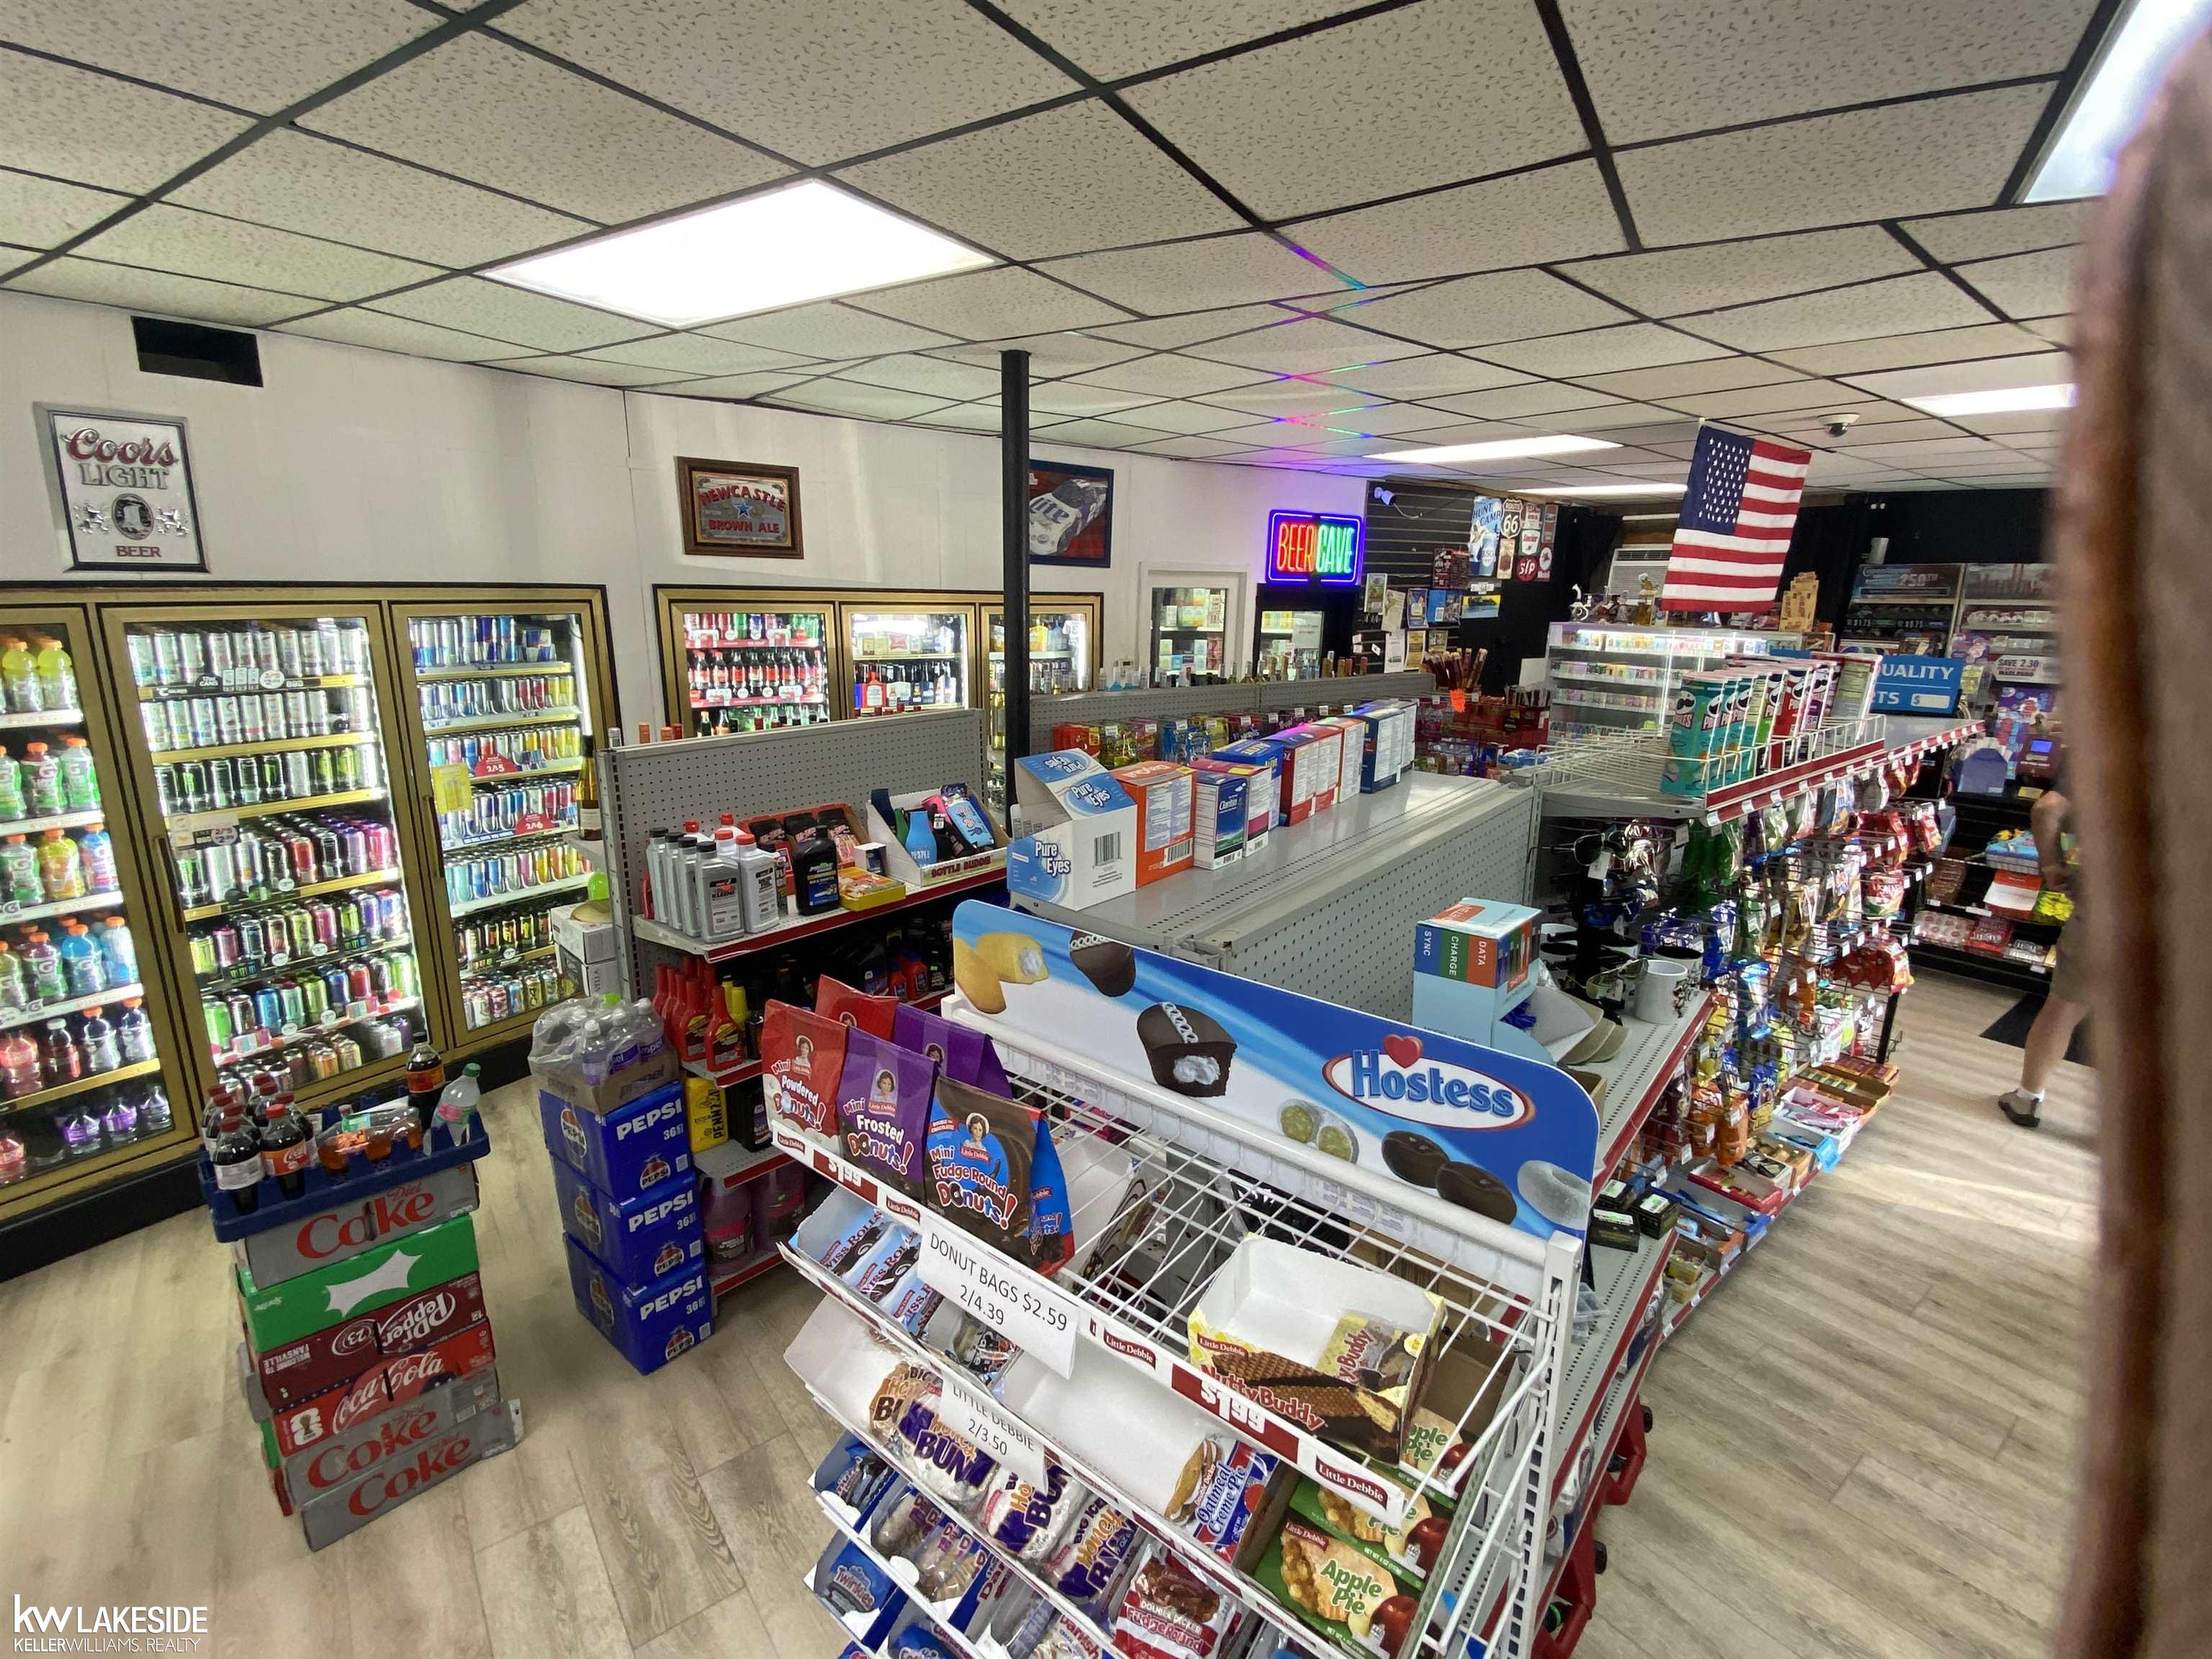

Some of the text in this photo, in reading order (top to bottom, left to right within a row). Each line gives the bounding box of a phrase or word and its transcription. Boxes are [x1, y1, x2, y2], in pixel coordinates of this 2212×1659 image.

[63, 427, 179, 468] Coors
[79, 463, 170, 490] LIGHT
[698, 485, 786, 512] NEWCASTLE
[709, 519, 780, 534] BROWN ALE
[1503, 514, 1519, 534] 66
[115, 545, 162, 559] BEER
[1276, 523, 1354, 574] BEER CAVE
[1881, 663, 1954, 680] UALITY
[1997, 658, 2016, 667] SAVE
[1044, 755, 1067, 770] Eyes
[1063, 760, 1087, 774] Pure
[1070, 782, 1093, 801] Pure
[1089, 787, 1111, 807] Eyes
[1035, 840, 1058, 859] Pure
[931, 863, 961, 878] BOTTLE
[1046, 858, 1071, 877] Eyes
[1423, 930, 1487, 976] SYNC CHARGE DATA
[770, 1058, 791, 1076] Mini
[1351, 1048, 1516, 1118] Hostess
[781, 1075, 819, 1107] Powdered
[842, 1097, 865, 1117] Mini
[616, 1098, 683, 1141] PEPSI
[711, 1089, 724, 1139] PENNZ
[772, 1090, 827, 1131] Donuts!
[562, 1123, 585, 1144] PEPSI
[778, 1135, 805, 1153] Little Debbie
[855, 1114, 905, 1146] Frosted
[847, 1132, 914, 1176] Donuts!
[930, 1144, 956, 1162] Mini
[642, 1167, 671, 1187] PEPSI
[932, 1163, 1008, 1200] Fudge Round
[887, 1200, 919, 1220] Little Debbie
[936, 1181, 1018, 1230] Donuts!
[1033, 1189, 1051, 1200] ebbie
[296, 1192, 438, 1259] Coke
[629, 1190, 694, 1232] PEPSI
[848, 1210, 884, 1244] ROLLS
[655, 1254, 684, 1273] PEPSI
[861, 1269, 886, 1295] WISS
[930, 1231, 1068, 1332] DONUT BAGS $2.59
[639, 1275, 703, 1321] PEPSI
[959, 1284, 1005, 1326] 2/4.39
[382, 1292, 448, 1346] Pepper
[403, 1320, 433, 1344] Dr
[347, 1329, 367, 1346] 23
[667, 1336, 694, 1355] PEPSI
[1105, 1333, 1155, 1364] Little Debbie
[1199, 1336, 1246, 1357] Little Debbie
[1337, 1329, 1370, 1369] Buddy
[263, 1343, 310, 1368] FANSVILLE
[953, 1382, 1035, 1452] LITTLE DEBBIE
[1259, 1386, 1326, 1431] Buddy
[307, 1411, 438, 1490] Coke
[968, 1418, 1009, 1457] 2/3.50
[1404, 1437, 1434, 1462] Pie
[1409, 1424, 1449, 1447] pple
[913, 1428, 977, 1485] BUN
[349, 1435, 471, 1516] Coke
[1194, 1462, 1217, 1506] Double Decker
[1318, 1463, 1384, 1503] Little Debbie
[1196, 1460, 1232, 1524] Oatmeal
[1208, 1489, 1236, 1535] Creme
[1228, 1465, 1246, 1493] Pie
[1076, 1508, 1125, 1568] Honey
[1285, 1521, 1326, 1548] Little Debbie
[833, 1564, 876, 1611] Twinkies
[1320, 1558, 1382, 1598] Apple
[1331, 1586, 1366, 1615] Pie
[1124, 1602, 1204, 1652] Fudge Round
[1140, 1599, 1202, 1636] DOUBLE DECKER
